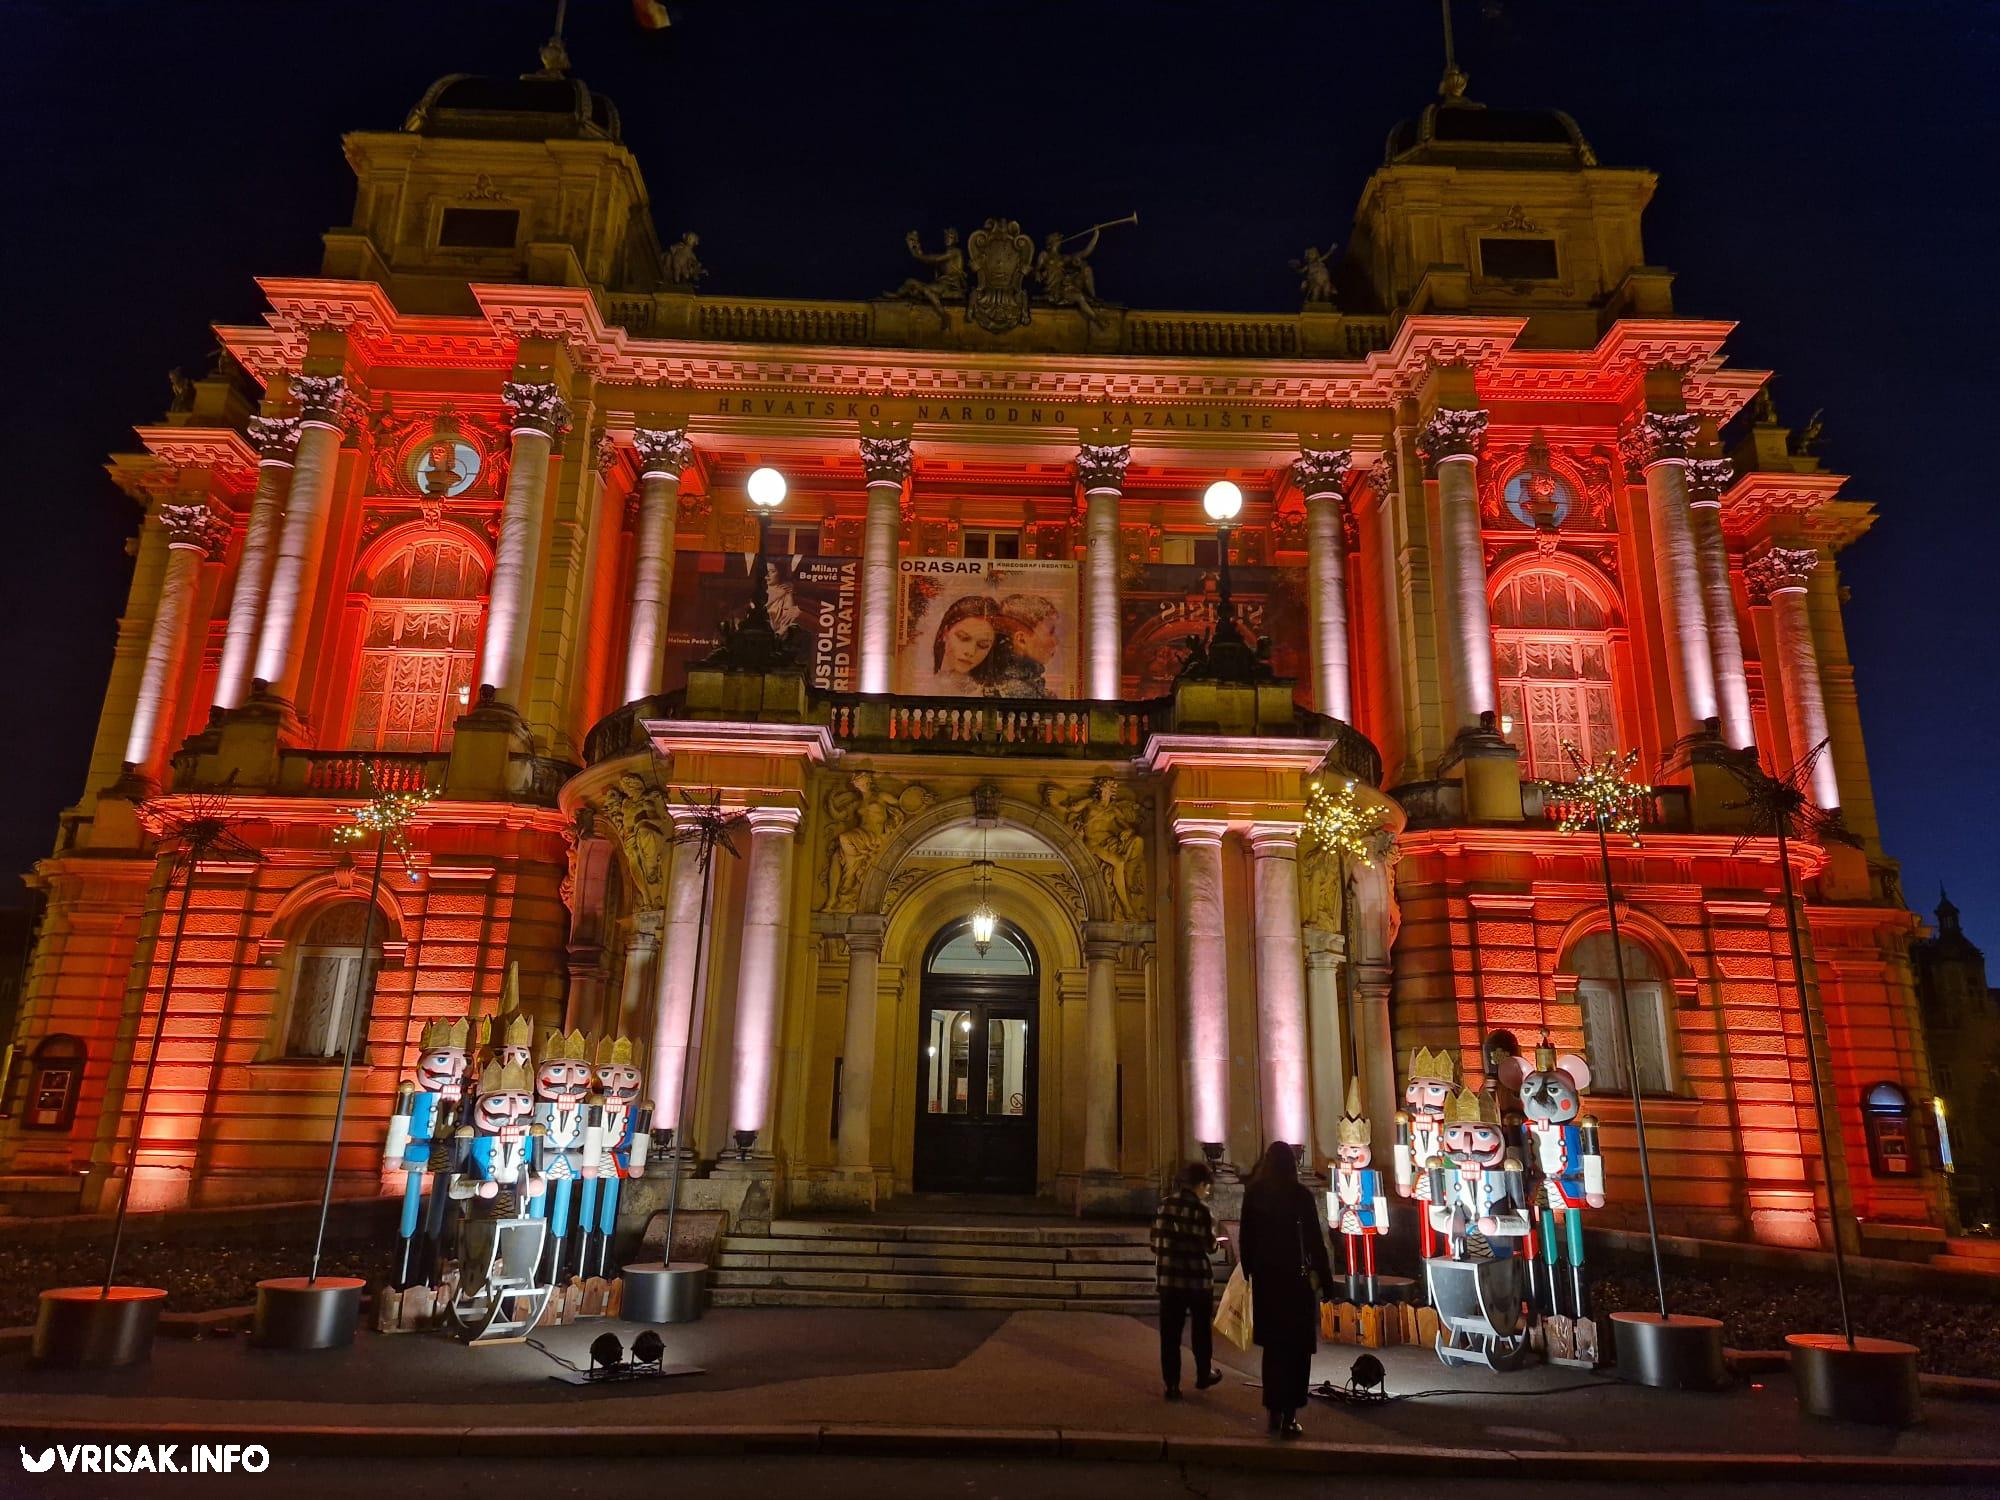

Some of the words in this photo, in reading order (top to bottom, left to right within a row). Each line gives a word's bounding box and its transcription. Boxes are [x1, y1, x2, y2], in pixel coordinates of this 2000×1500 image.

[718, 398, 880, 418] HRVATSKO
[918, 405, 1065, 424] NARODNO
[1103, 410, 1273, 429] KAZALIŠTE
[799, 571, 838, 583] Begović
[811, 564, 838, 573] Milan
[835, 562, 856, 648] VRATIMA
[815, 600, 836, 690] USTOLOV
[833, 652, 850, 692] RED
